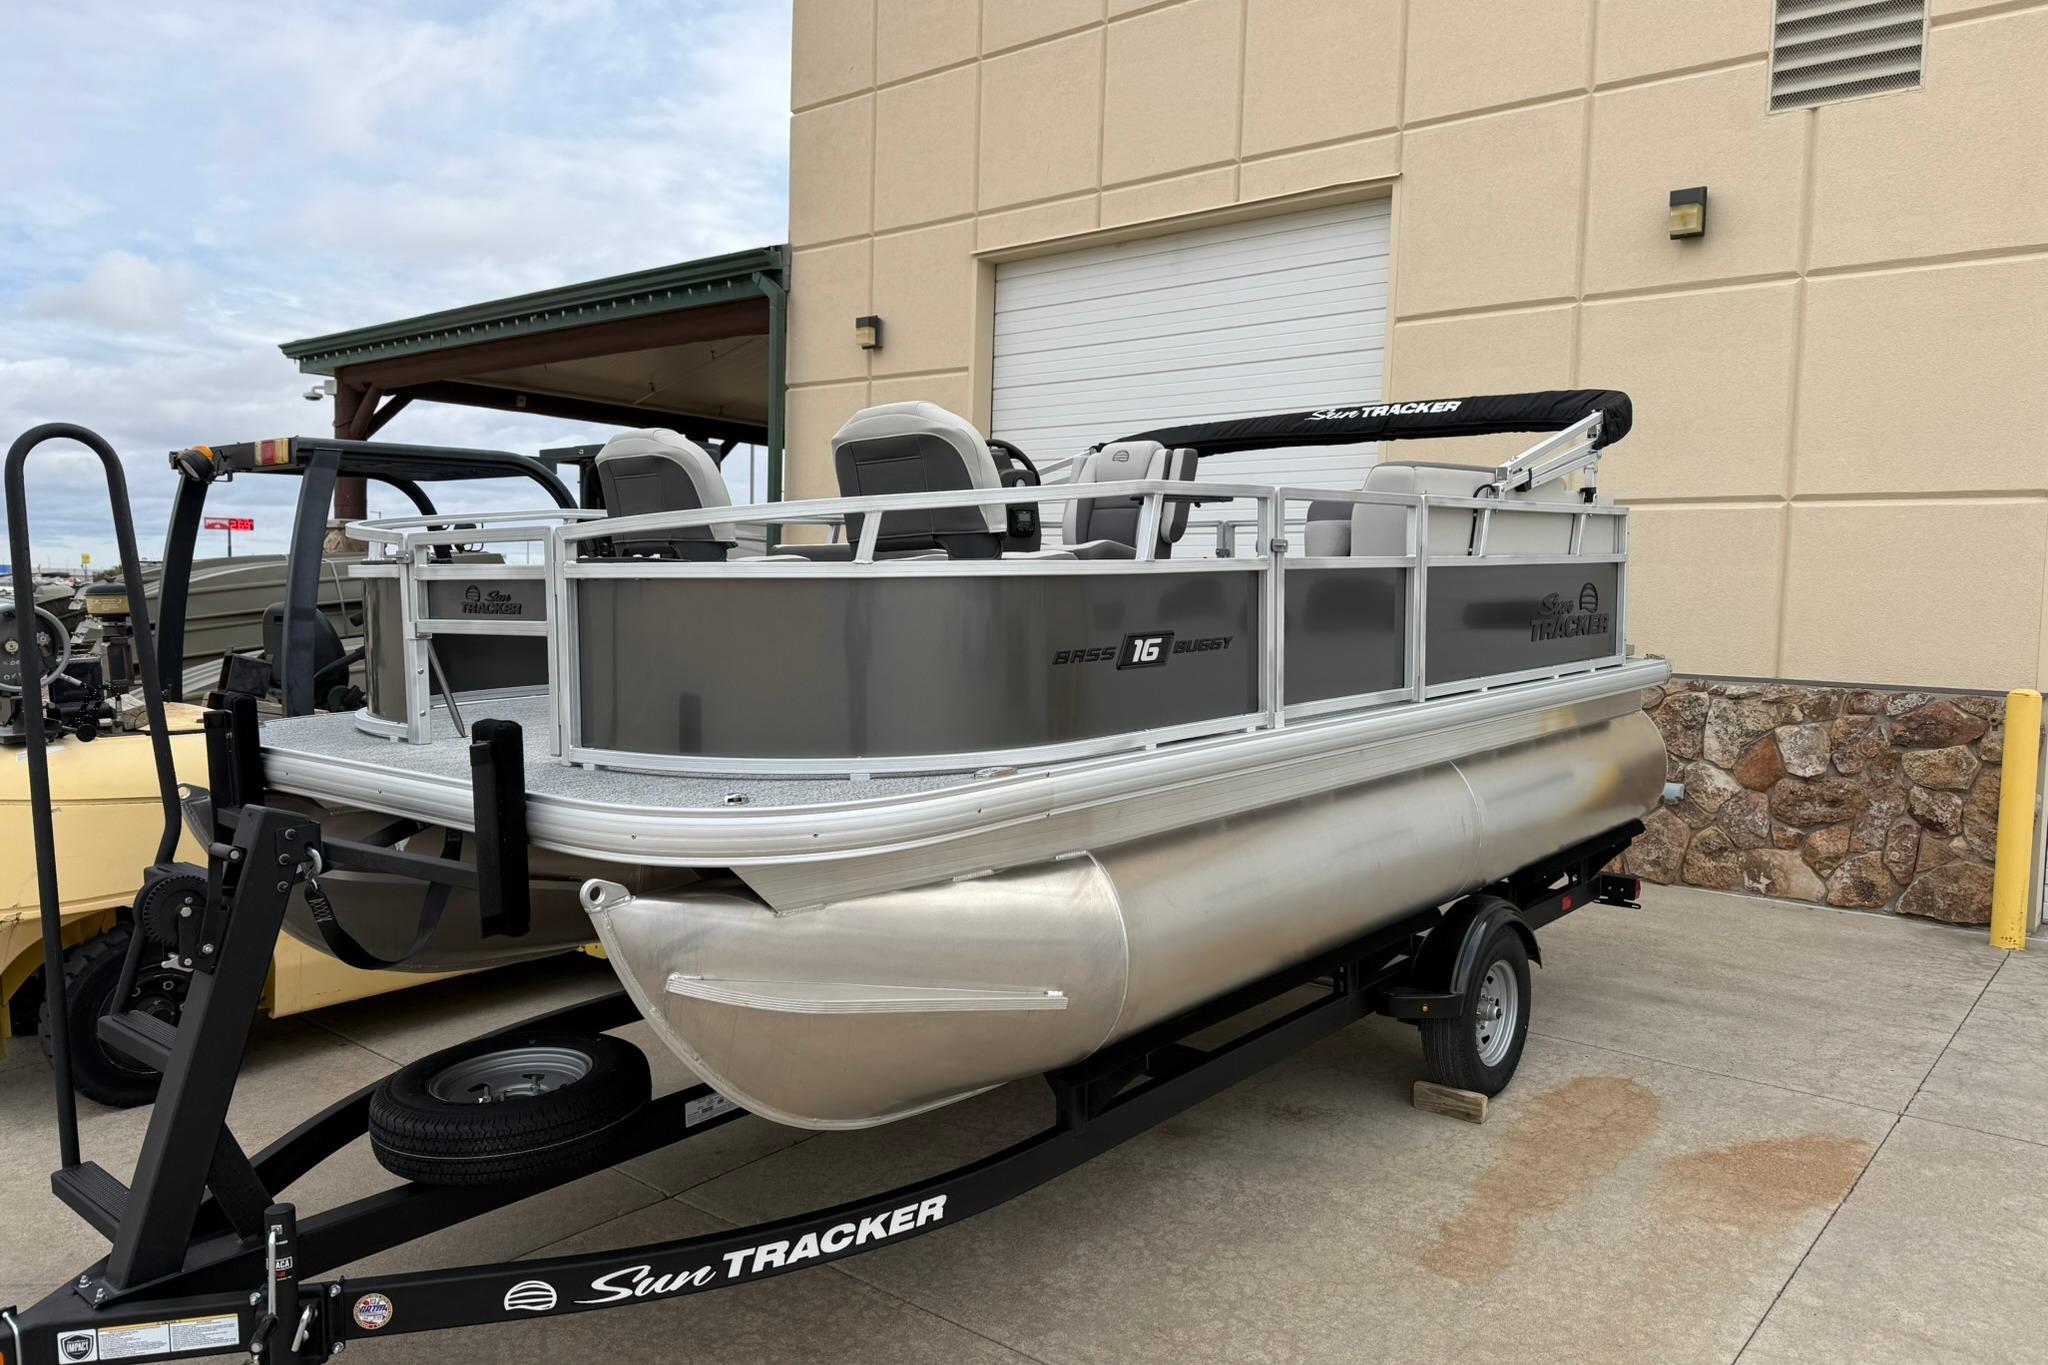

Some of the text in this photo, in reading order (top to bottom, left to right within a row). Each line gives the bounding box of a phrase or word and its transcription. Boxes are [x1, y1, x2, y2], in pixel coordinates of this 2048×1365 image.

[1304, 400, 1462, 421] Sun TRACKER
[461, 602, 523, 615] TRACKER
[1537, 592, 1574, 617] Sun
[1529, 613, 1609, 642] TRACKER
[1052, 635, 1234, 665] BASS 16 BUGGY
[573, 1194, 947, 1304] Sun TRACKER
[66, 1340, 89, 1353] IMPACT
